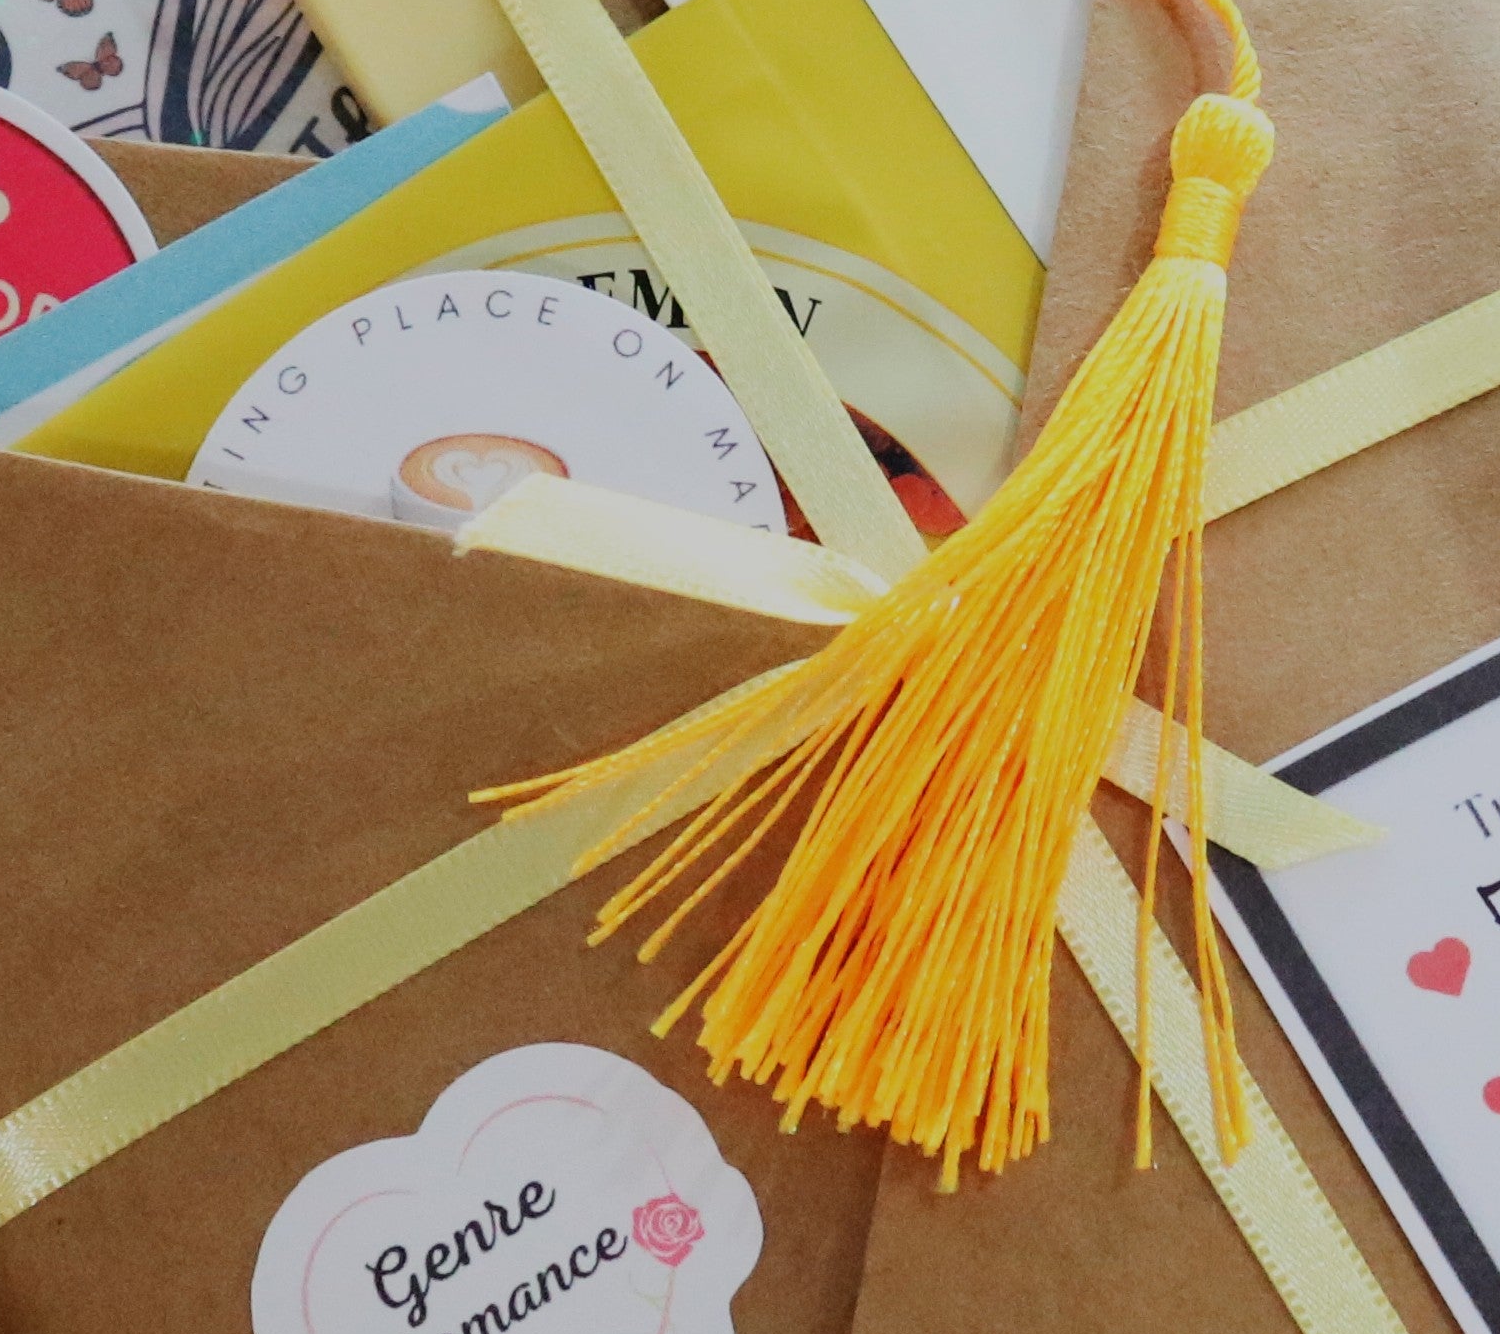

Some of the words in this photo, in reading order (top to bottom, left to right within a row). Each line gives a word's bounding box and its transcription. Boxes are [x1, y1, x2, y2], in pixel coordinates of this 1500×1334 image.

[203, 365, 307, 491] ING
[351, 289, 560, 346] PLACE
[613, 329, 684, 389] ON
[704, 427, 771, 533] MA
[363, 1179, 557, 1329] Genre
